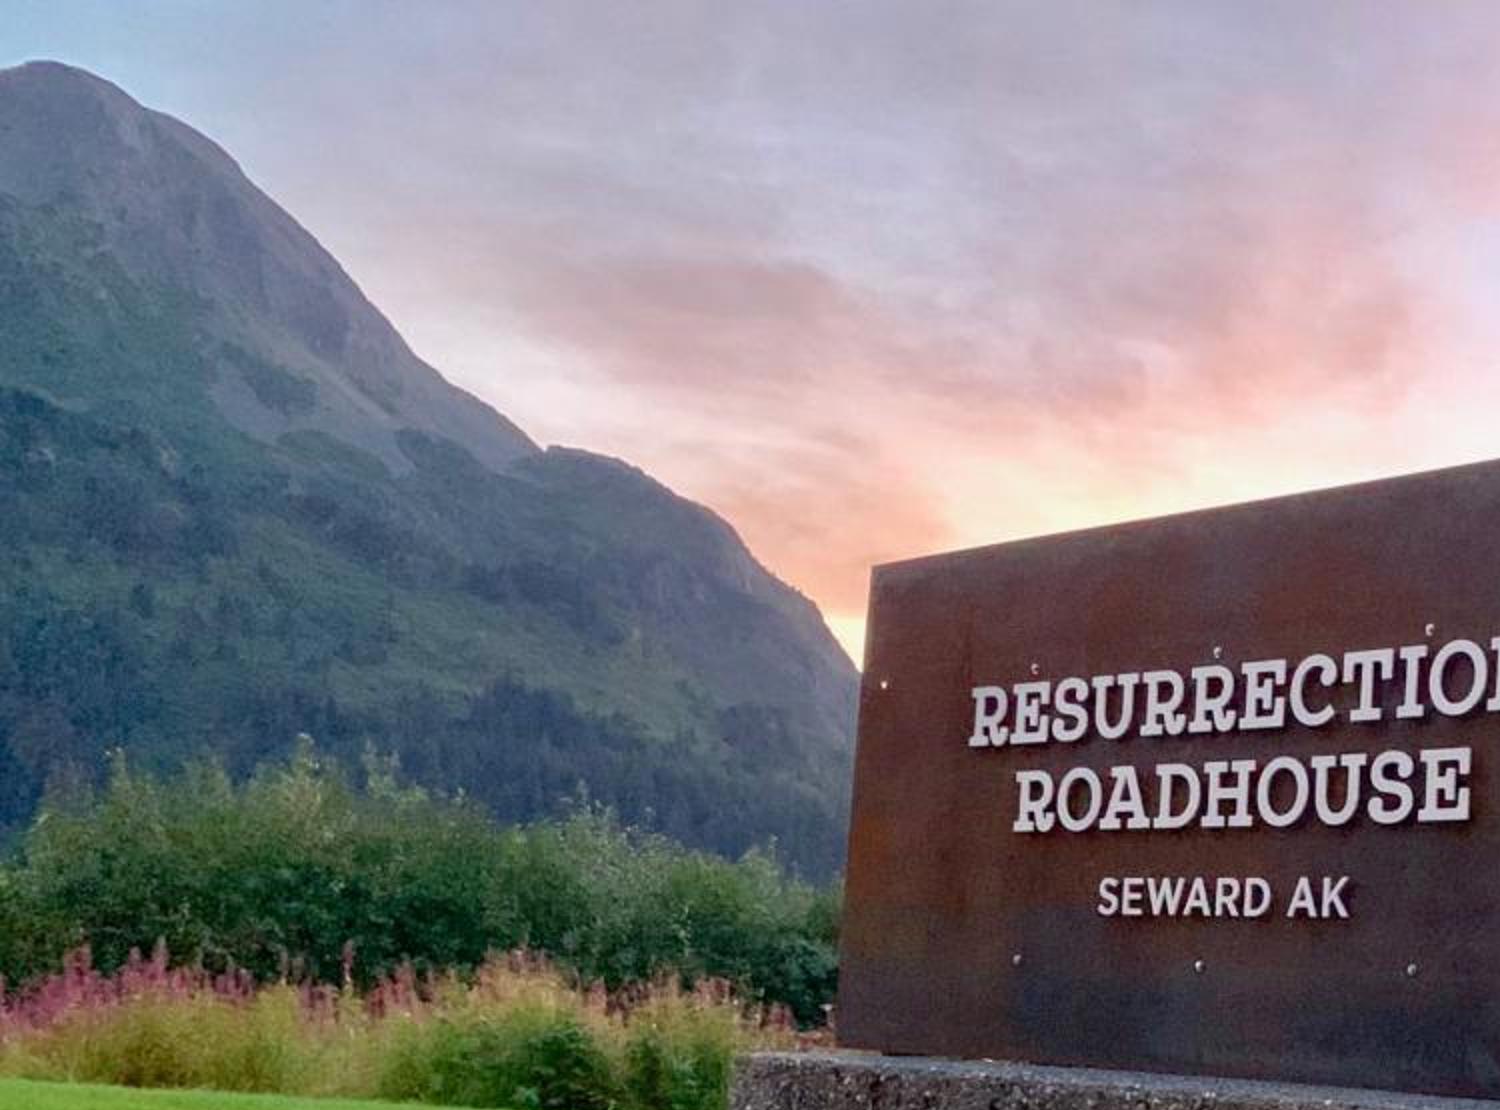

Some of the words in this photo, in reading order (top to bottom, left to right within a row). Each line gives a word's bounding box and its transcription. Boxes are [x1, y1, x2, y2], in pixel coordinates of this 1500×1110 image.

[1013, 747, 1472, 832] ROADHOUSE
[1098, 877, 1271, 916] SEWARD
[1286, 876, 1350, 917] AK
